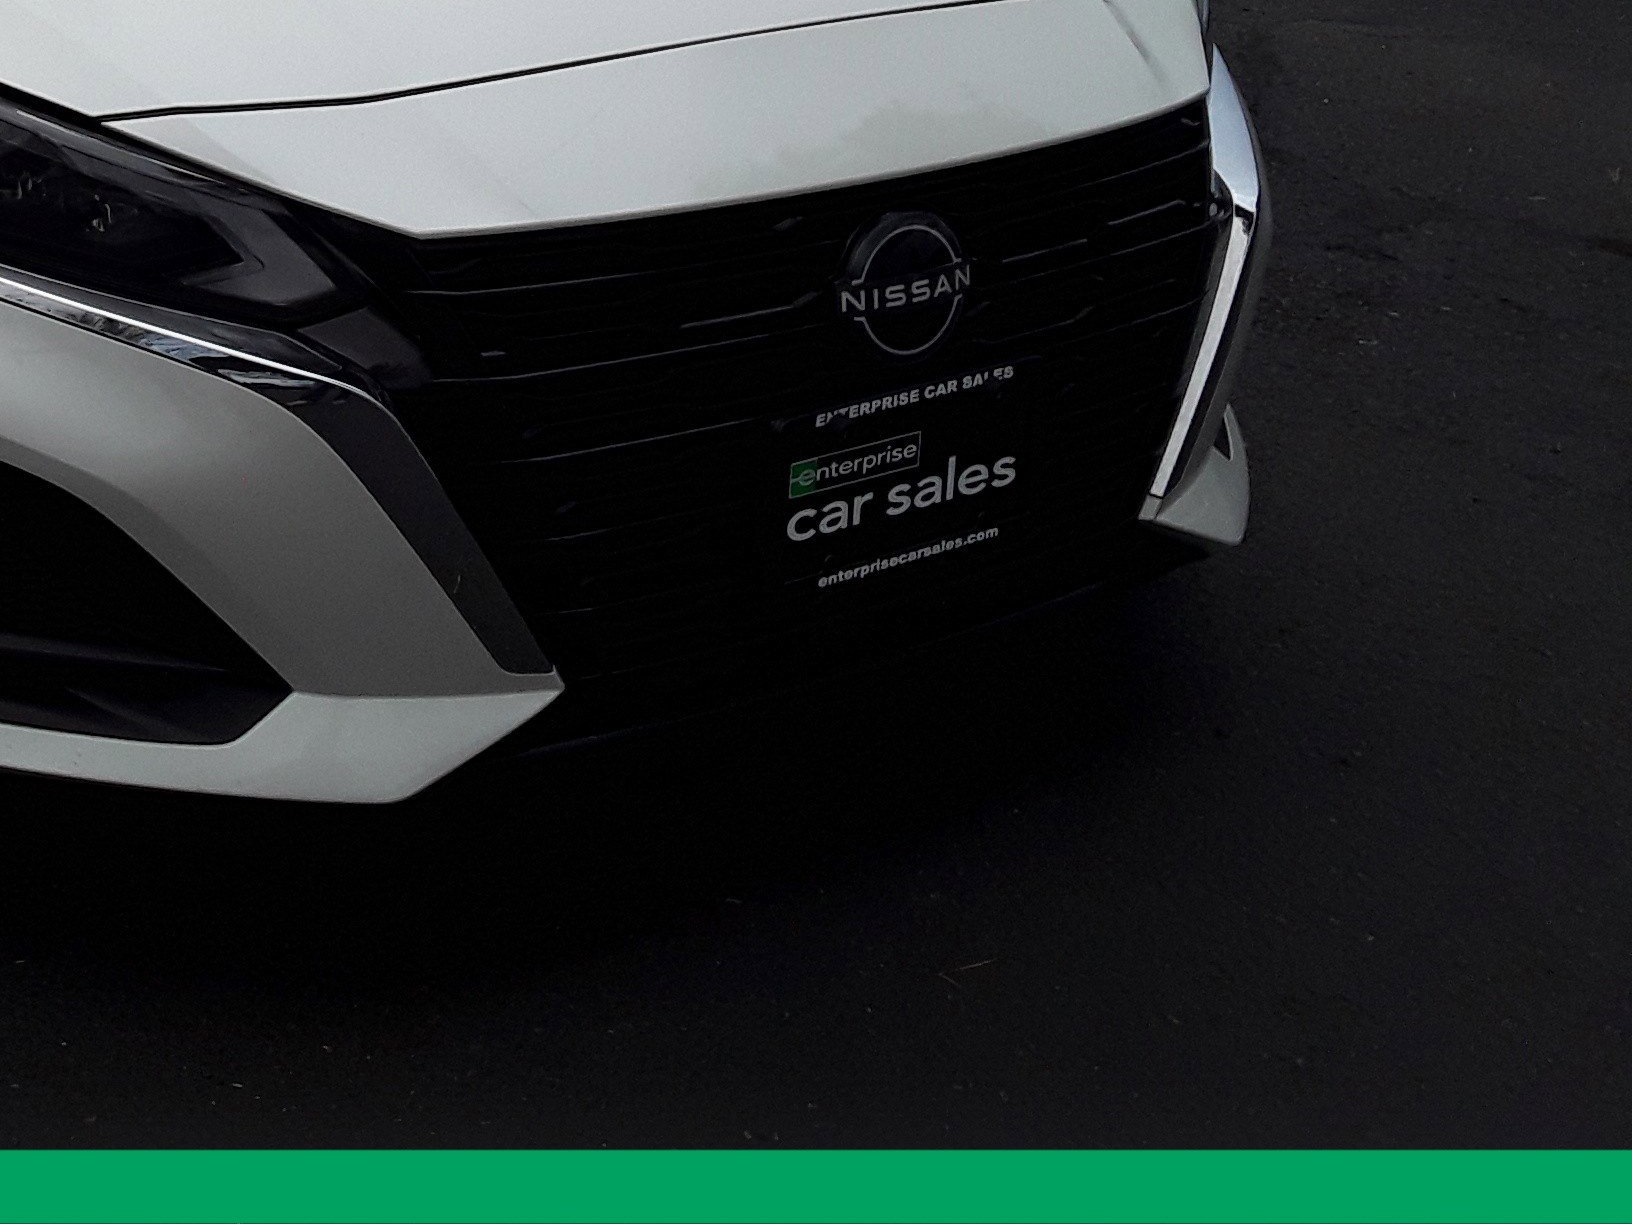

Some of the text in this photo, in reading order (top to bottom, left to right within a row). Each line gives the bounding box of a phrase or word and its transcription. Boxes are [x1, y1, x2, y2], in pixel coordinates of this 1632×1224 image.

[841, 264, 971, 313] NISSAN
[924, 380, 958, 399] CAR
[795, 444, 917, 486] enterprise
[786, 456, 1016, 542] car sales
[817, 528, 999, 588] enterprisecarsales.com
